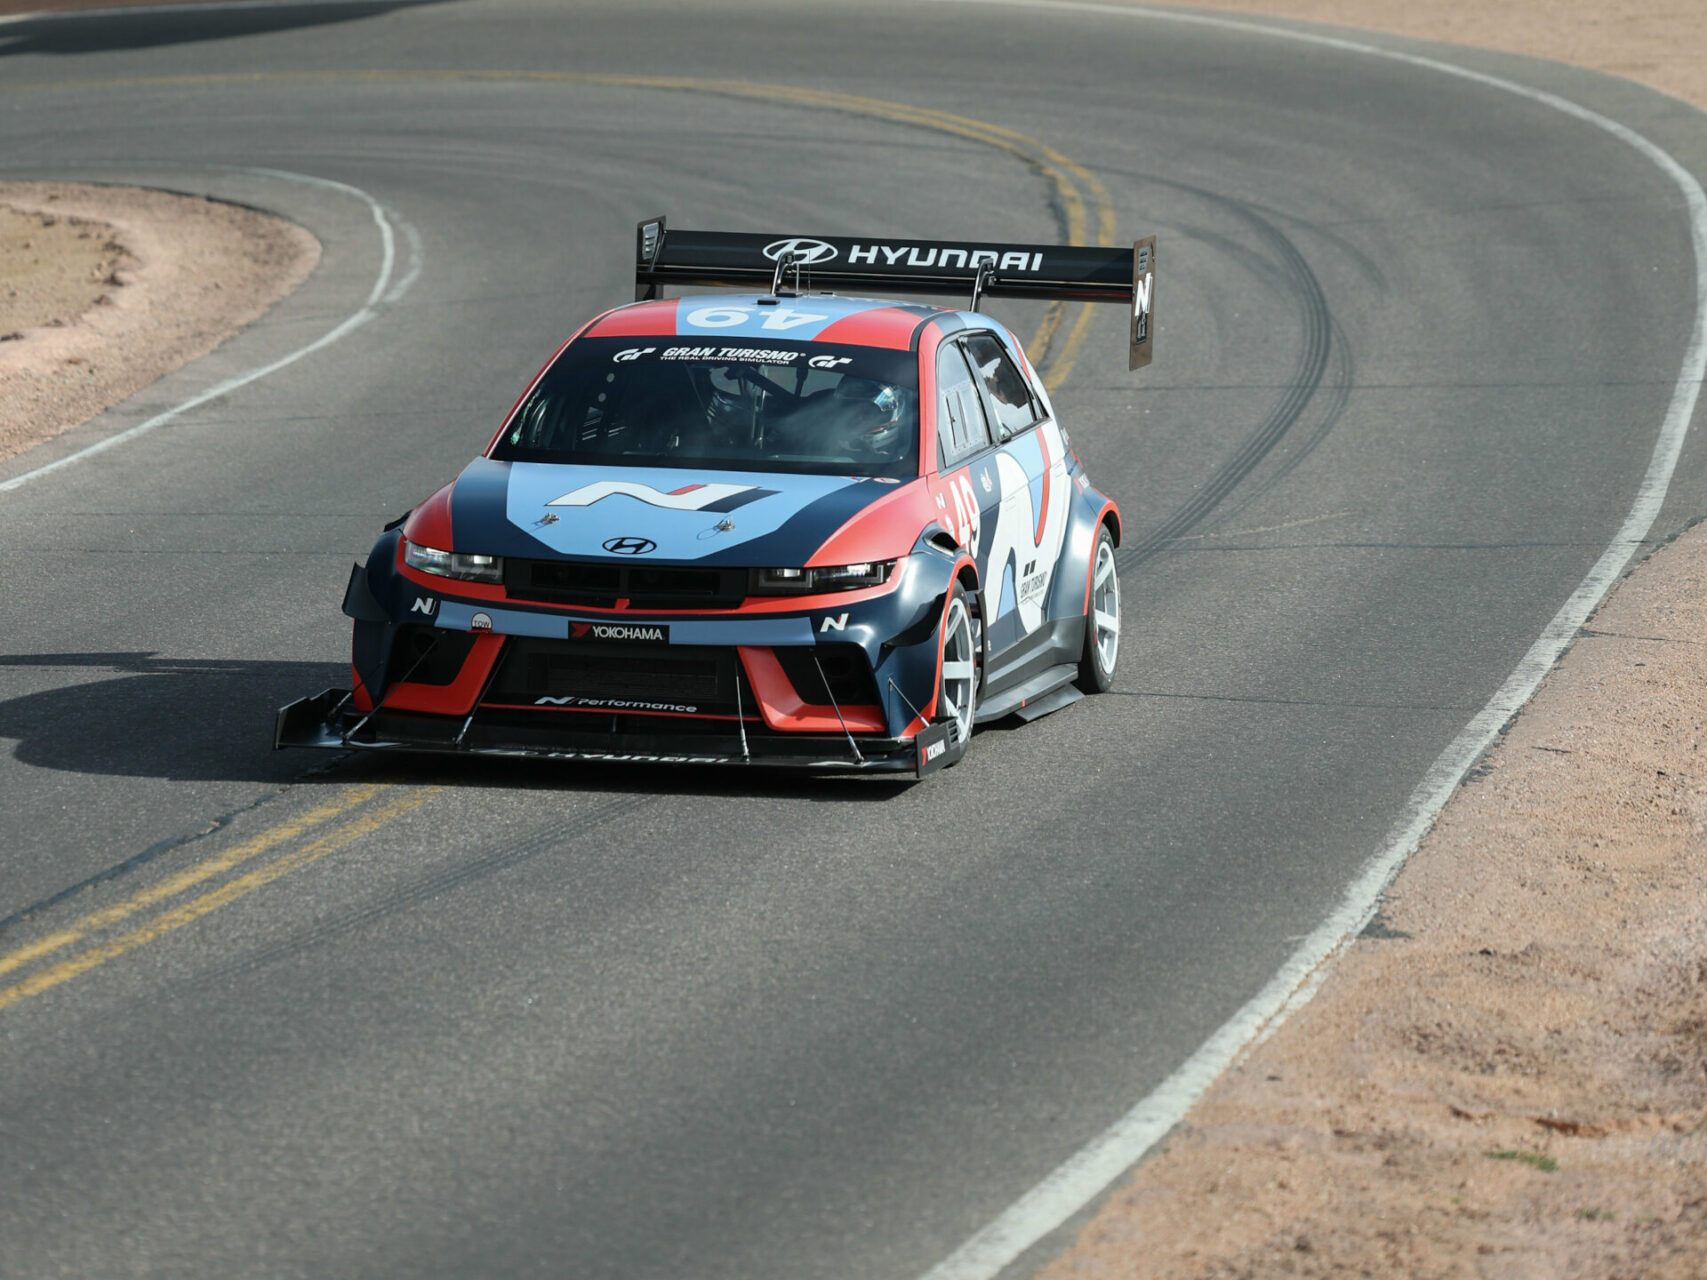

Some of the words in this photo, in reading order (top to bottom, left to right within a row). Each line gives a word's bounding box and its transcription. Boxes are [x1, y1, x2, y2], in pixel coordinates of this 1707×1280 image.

[848, 245, 1043, 271] HYUNDAI
[662, 347, 716, 357] GRAN
[720, 348, 799, 361] TURISMO
[592, 625, 663, 640] YOKOHAMA
[578, 697, 698, 713] Performance
